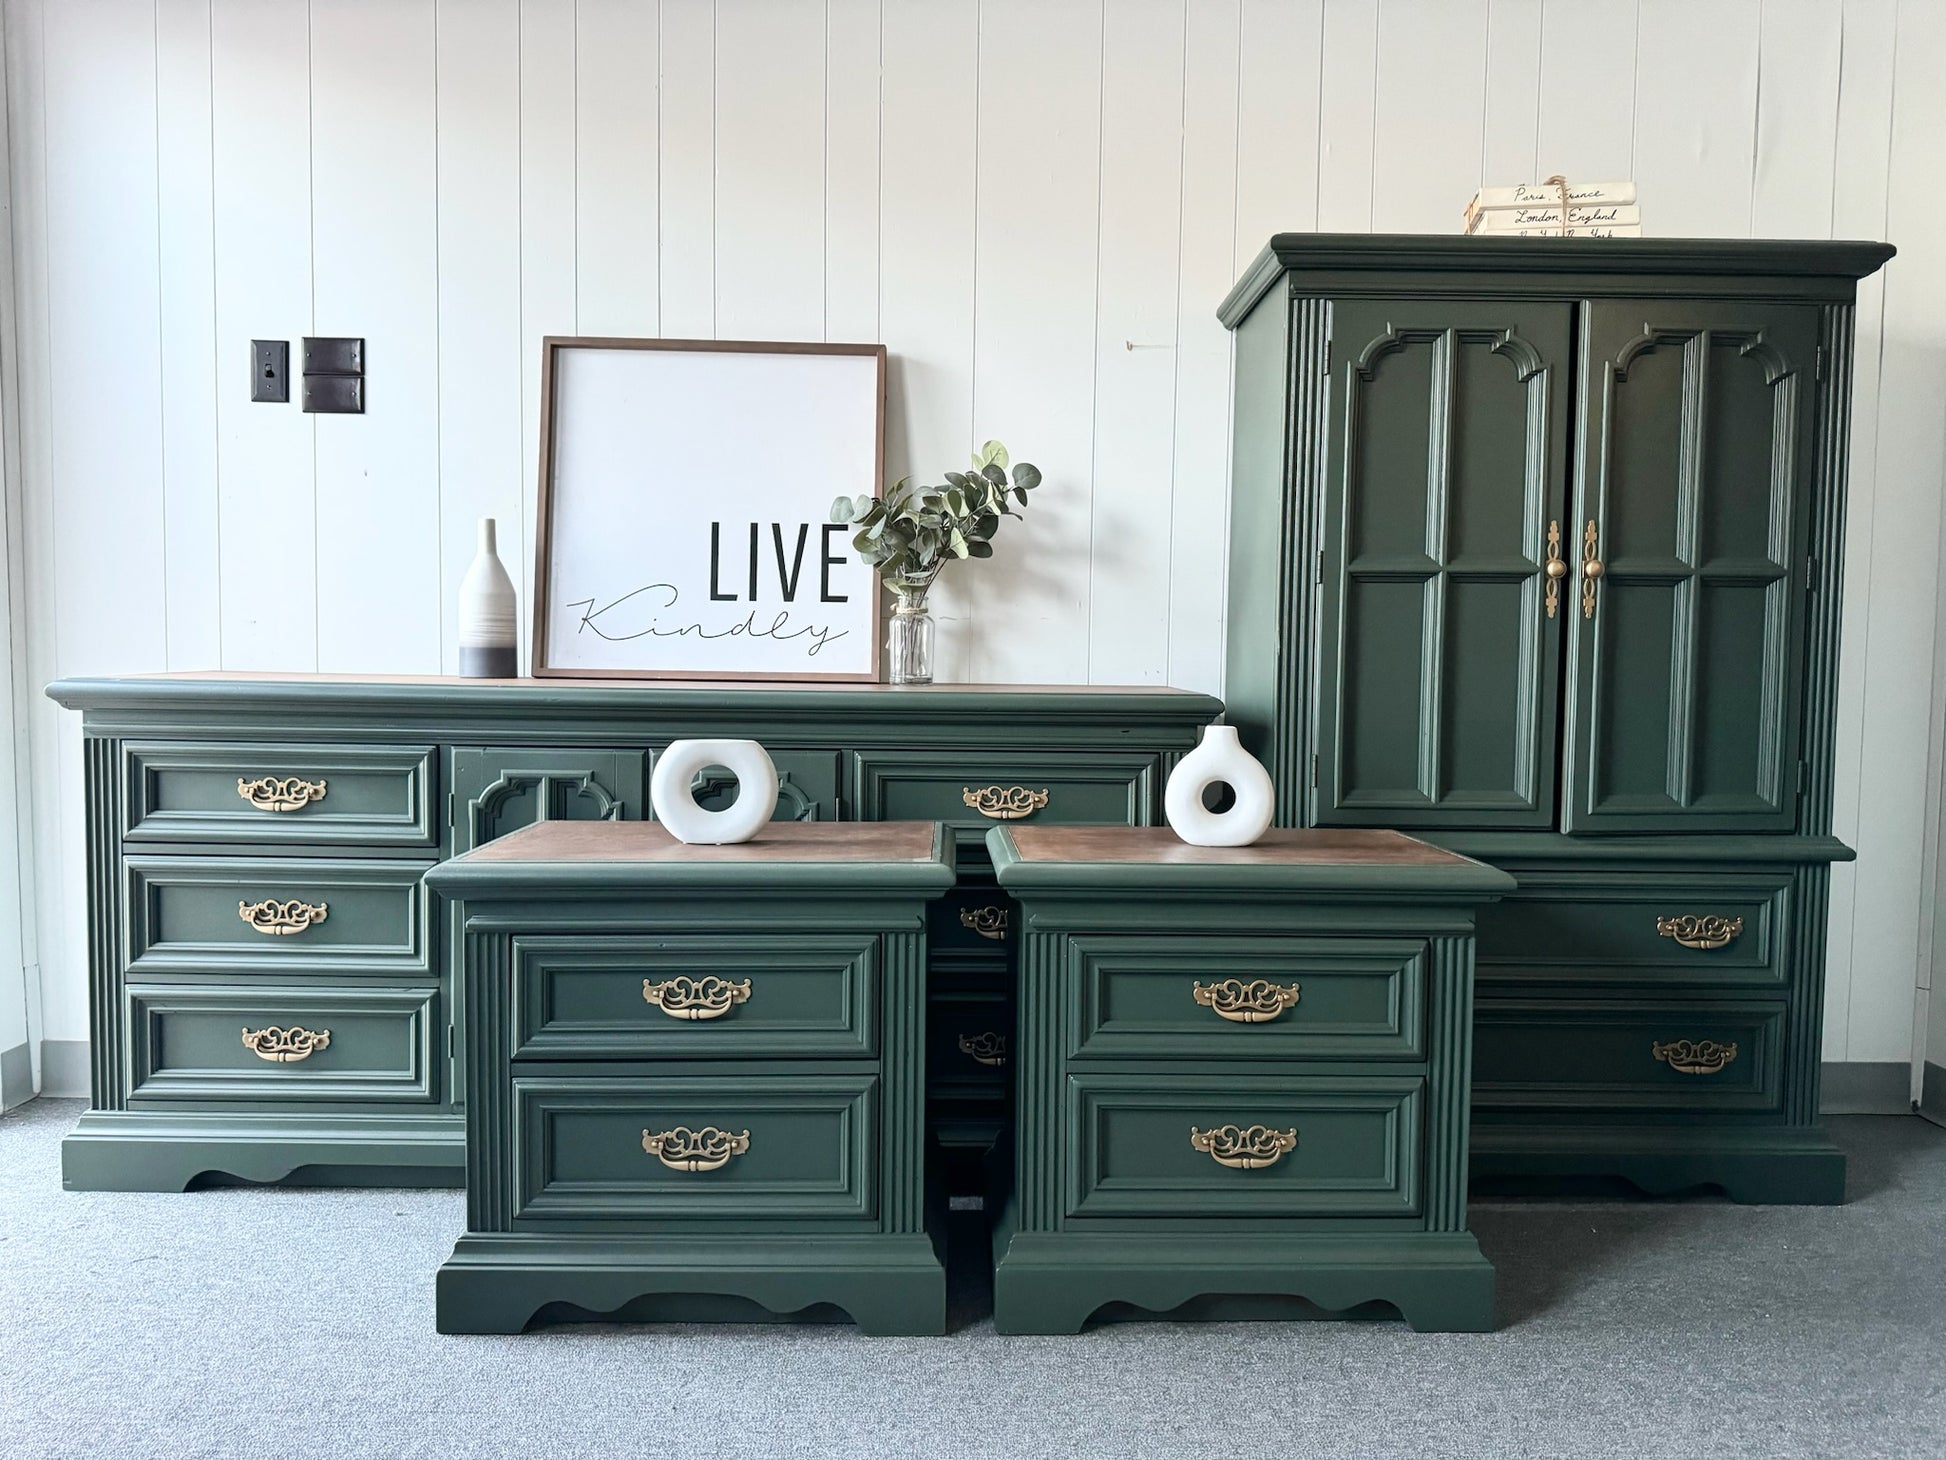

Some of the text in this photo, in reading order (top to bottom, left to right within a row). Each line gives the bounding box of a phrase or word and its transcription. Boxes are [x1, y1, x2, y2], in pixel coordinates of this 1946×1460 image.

[1514, 207, 1617, 225] London, England
[709, 521, 849, 603] LIVE
[566, 583, 850, 657] Kindly
